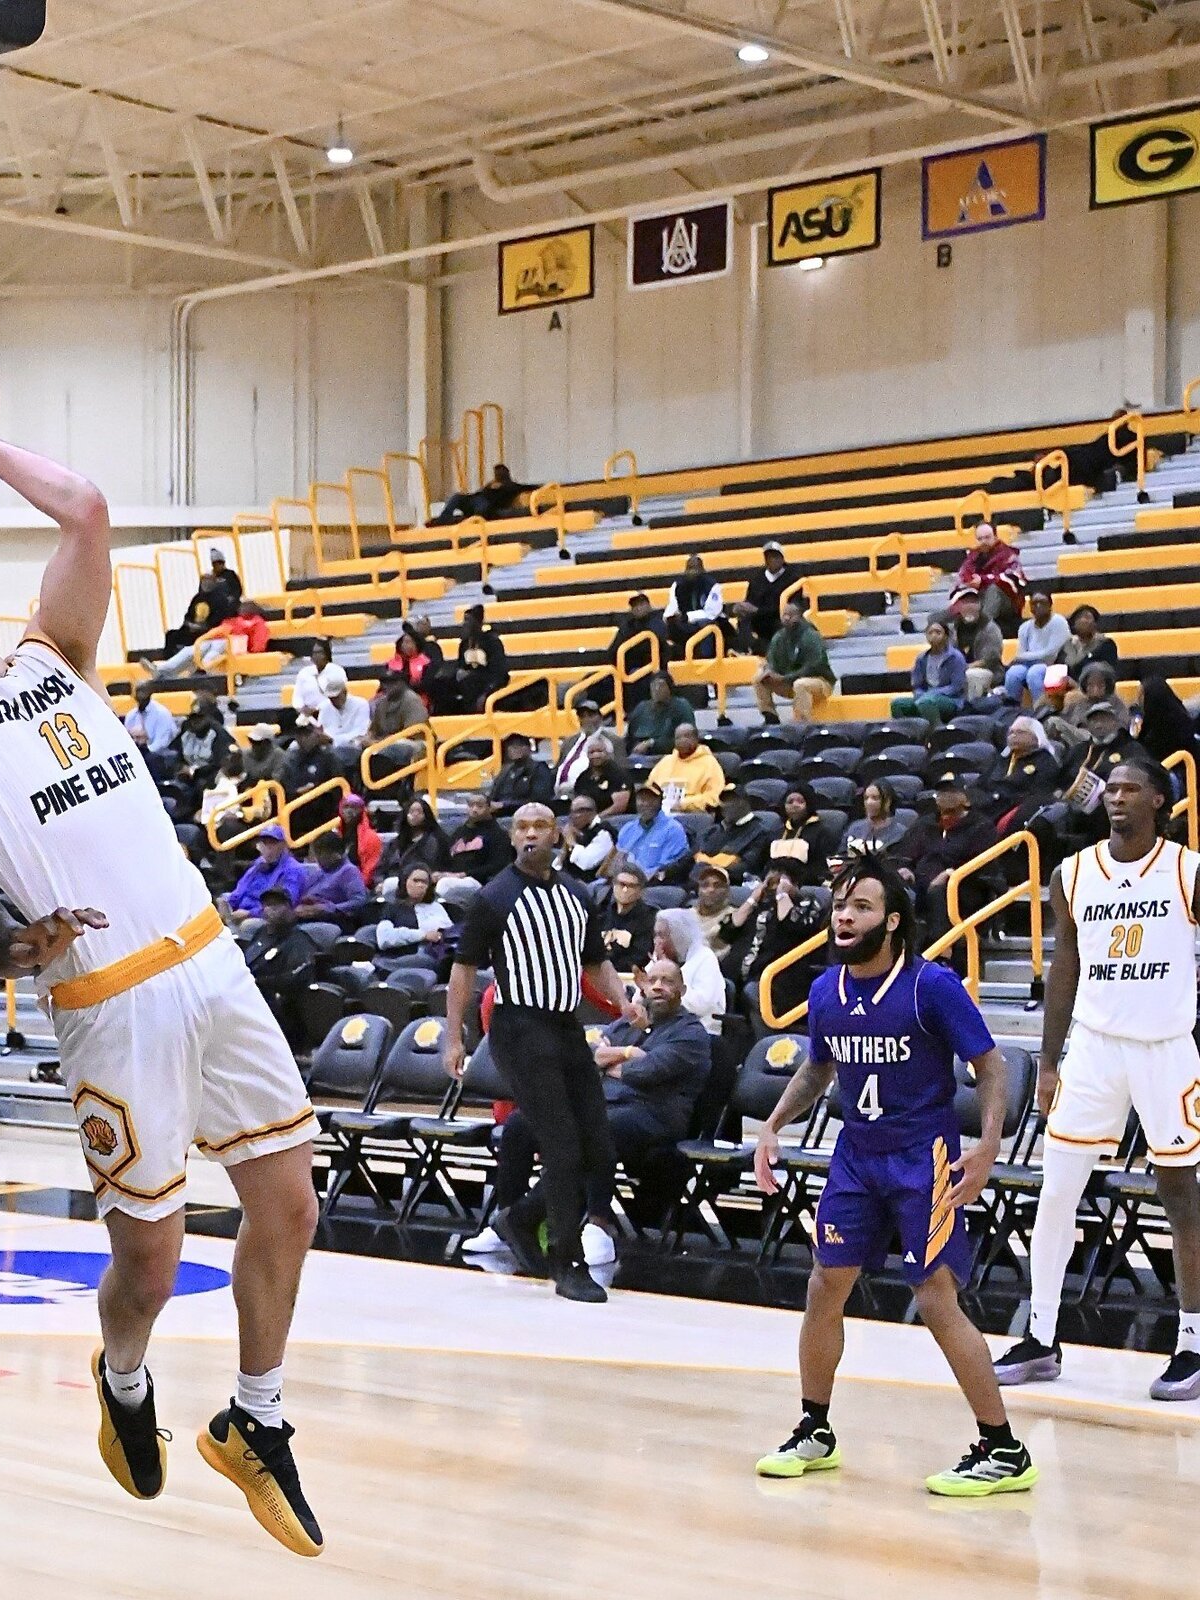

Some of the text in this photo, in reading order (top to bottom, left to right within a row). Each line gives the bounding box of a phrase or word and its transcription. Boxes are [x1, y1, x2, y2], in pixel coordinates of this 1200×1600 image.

[1117, 128, 1196, 183] G
[778, 204, 854, 248] ASU
[937, 244, 952, 268] B
[548, 310, 562, 331] A
[38, 712, 91, 770] 13
[29, 752, 137, 826] PINE BLUFF
[1083, 900, 1171, 922] ARKANSAS
[1108, 923, 1144, 958] 20
[1088, 961, 1170, 980] PINE BLUFF
[857, 1074, 884, 1121] 4
